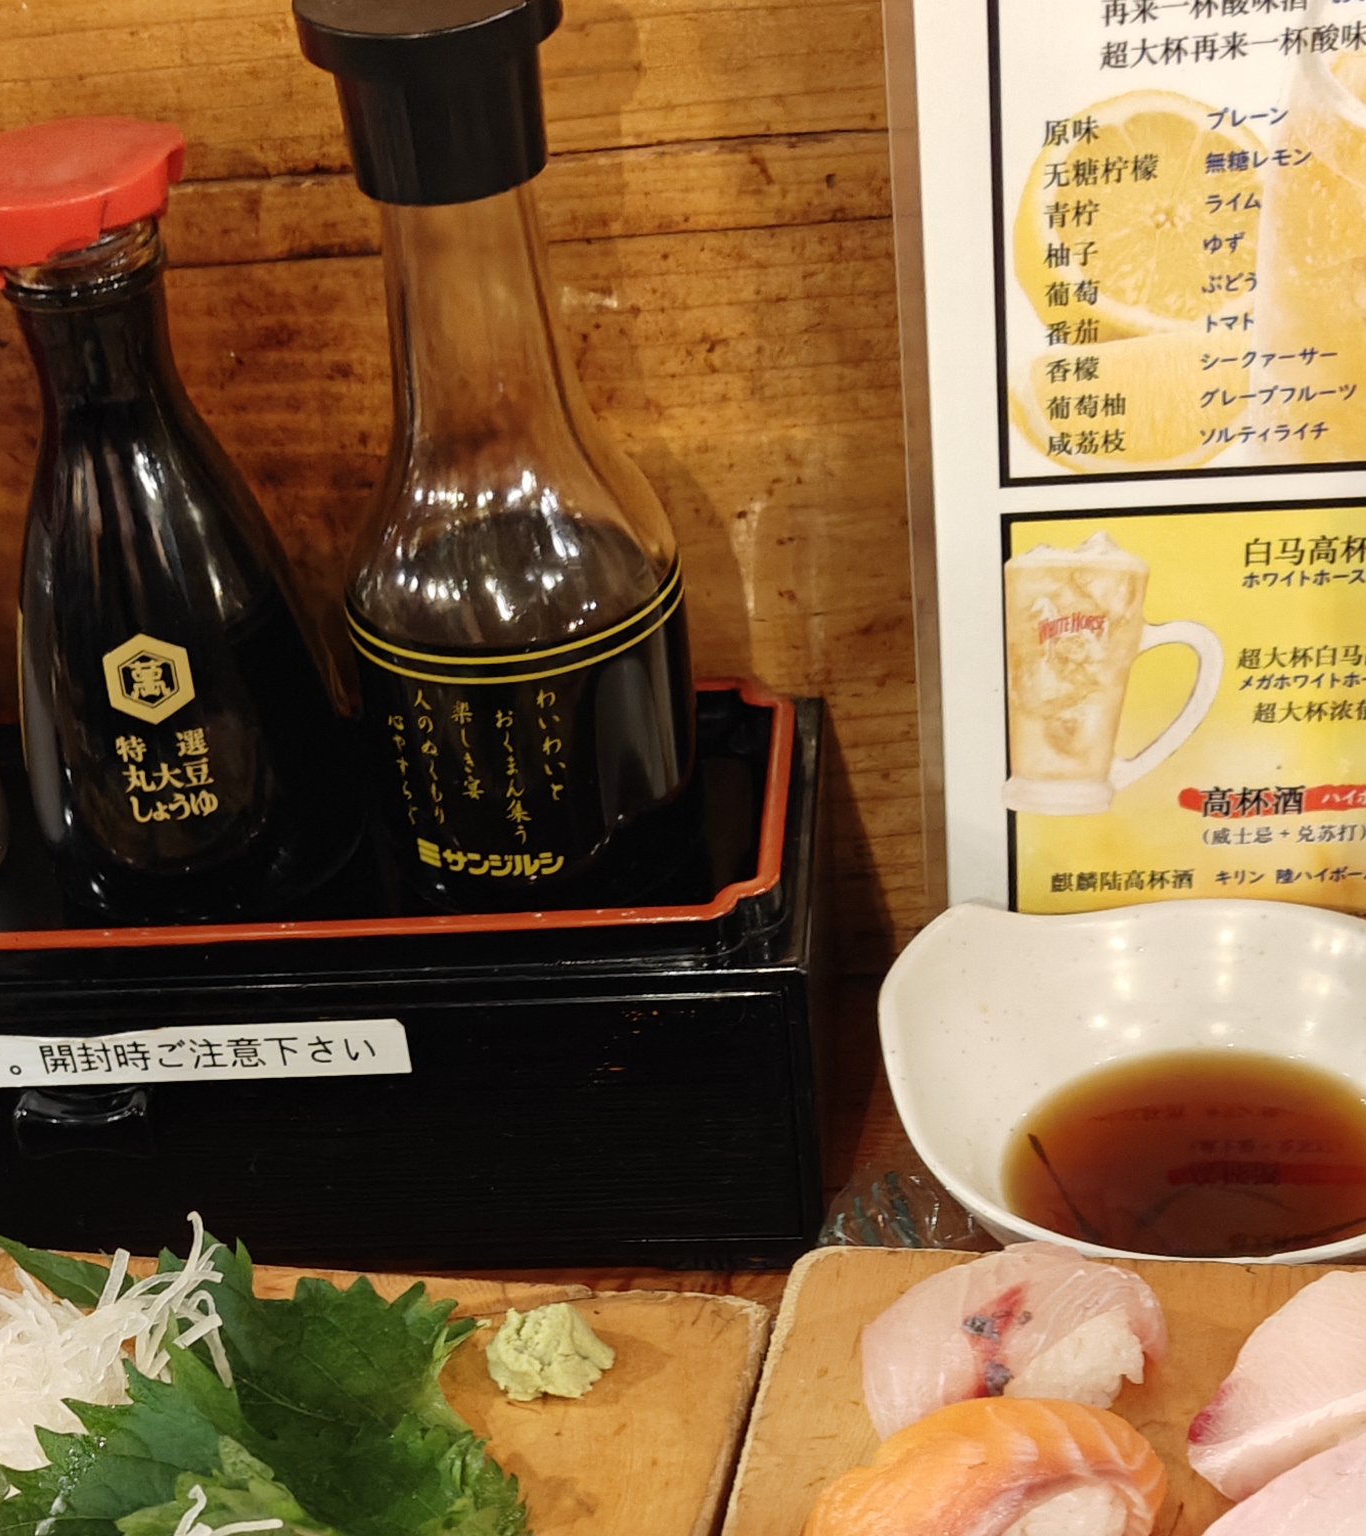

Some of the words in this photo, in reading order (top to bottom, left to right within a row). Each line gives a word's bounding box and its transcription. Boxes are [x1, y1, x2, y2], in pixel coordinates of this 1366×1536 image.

[1042, 116, 1100, 148] 原味
[1207, 108, 1290, 131] プレーン
[1043, 154, 1159, 189] 无糖柠檬
[1204, 149, 1313, 174] 無糖レモン
[1043, 200, 1100, 230] 青柠
[1204, 192, 1262, 214] ライム
[1043, 241, 1099, 269] 柚子
[1203, 231, 1245, 255] ゆず
[1045, 279, 1101, 307] 葡萄
[1201, 271, 1258, 294] ぶどう
[1045, 318, 1101, 347] 番茄
[1205, 312, 1255, 334] トマト
[1046, 393, 1126, 420] 葡萄柚
[1199, 383, 1357, 408] グレープフルーツ
[1046, 429, 1126, 456] 咸荔枝
[1199, 421, 1329, 445] ソルティライチ
[121, 757, 215, 794] 丸大豆
[129, 789, 219, 824] しょうゆ
[1200, 785, 1306, 818] 高杯酒
[441, 848, 565, 878] サンジルシ
[1215, 870, 1265, 886] キリン
